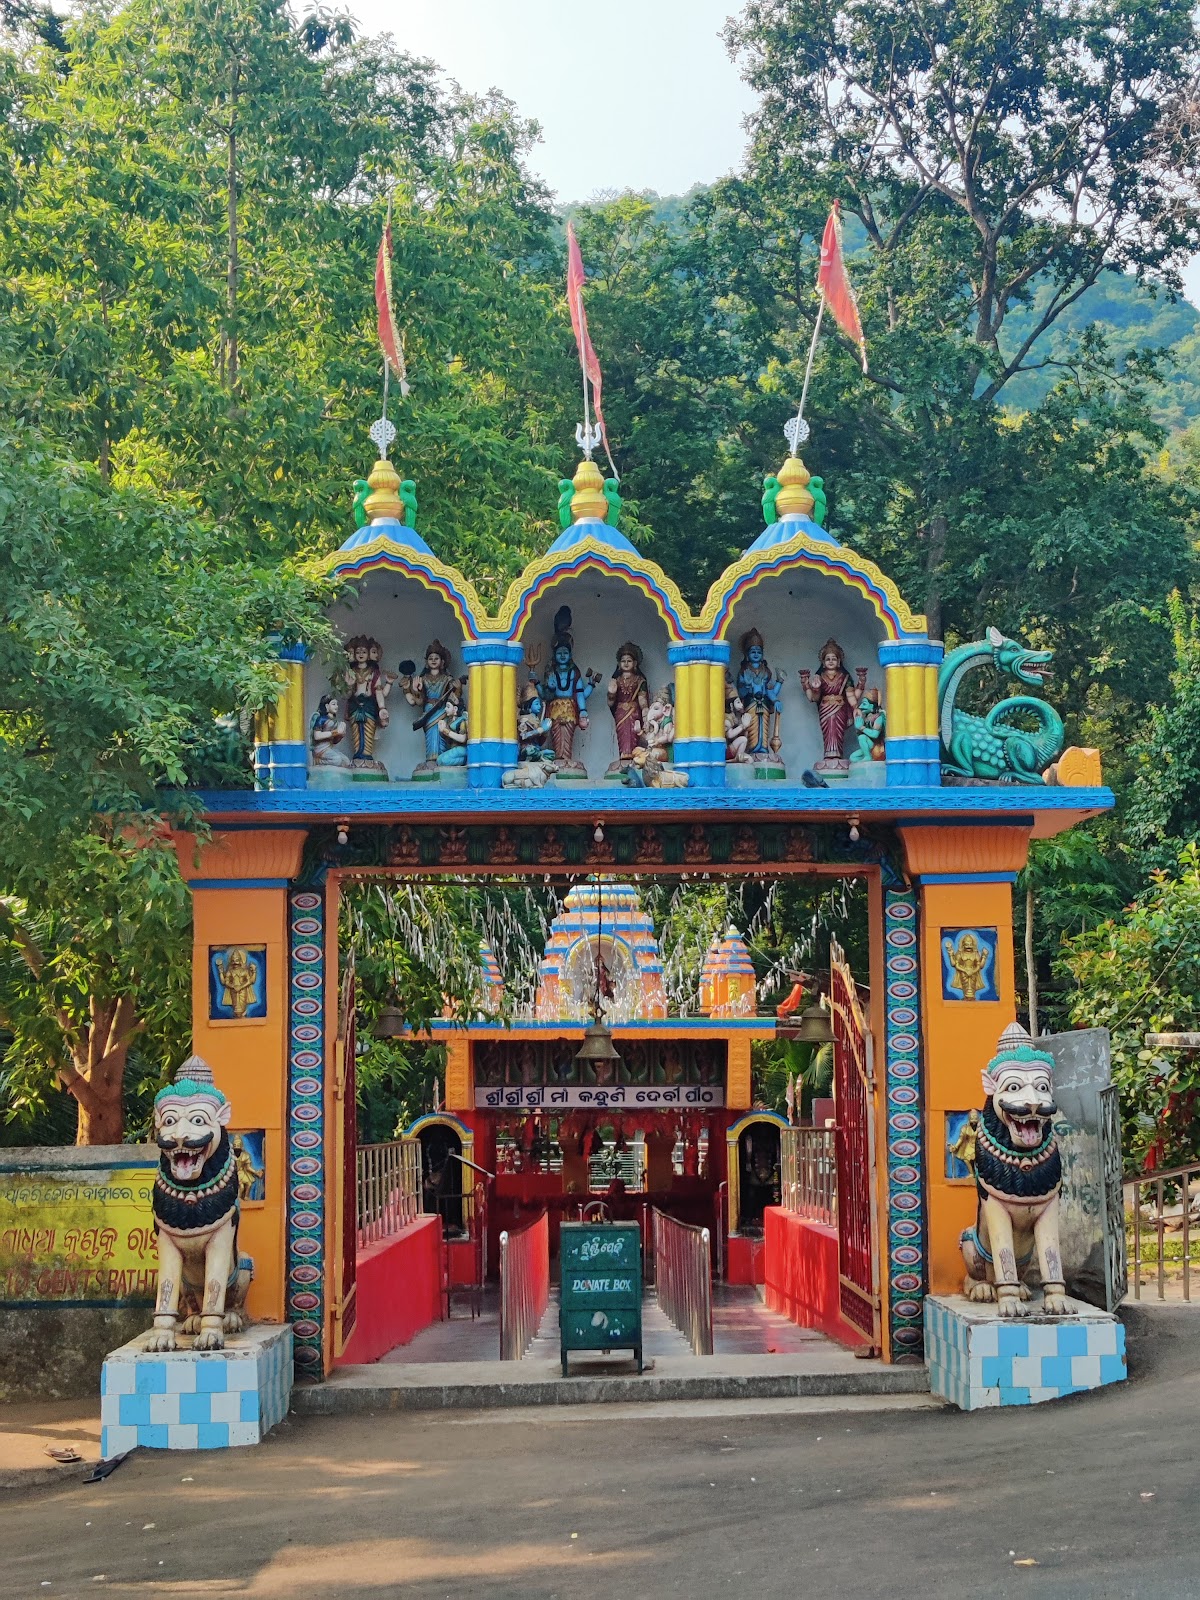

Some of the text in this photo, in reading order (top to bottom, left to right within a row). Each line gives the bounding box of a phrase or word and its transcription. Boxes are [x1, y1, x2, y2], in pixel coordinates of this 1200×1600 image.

[635, 1086, 681, 1103] ଦେବୀ
[685, 1086, 714, 1103] ପୀଠ
[36, 1268, 106, 1296] GENTS
[107, 1268, 159, 1296] BATHT
[572, 1278, 632, 1292] DONATE BOX
